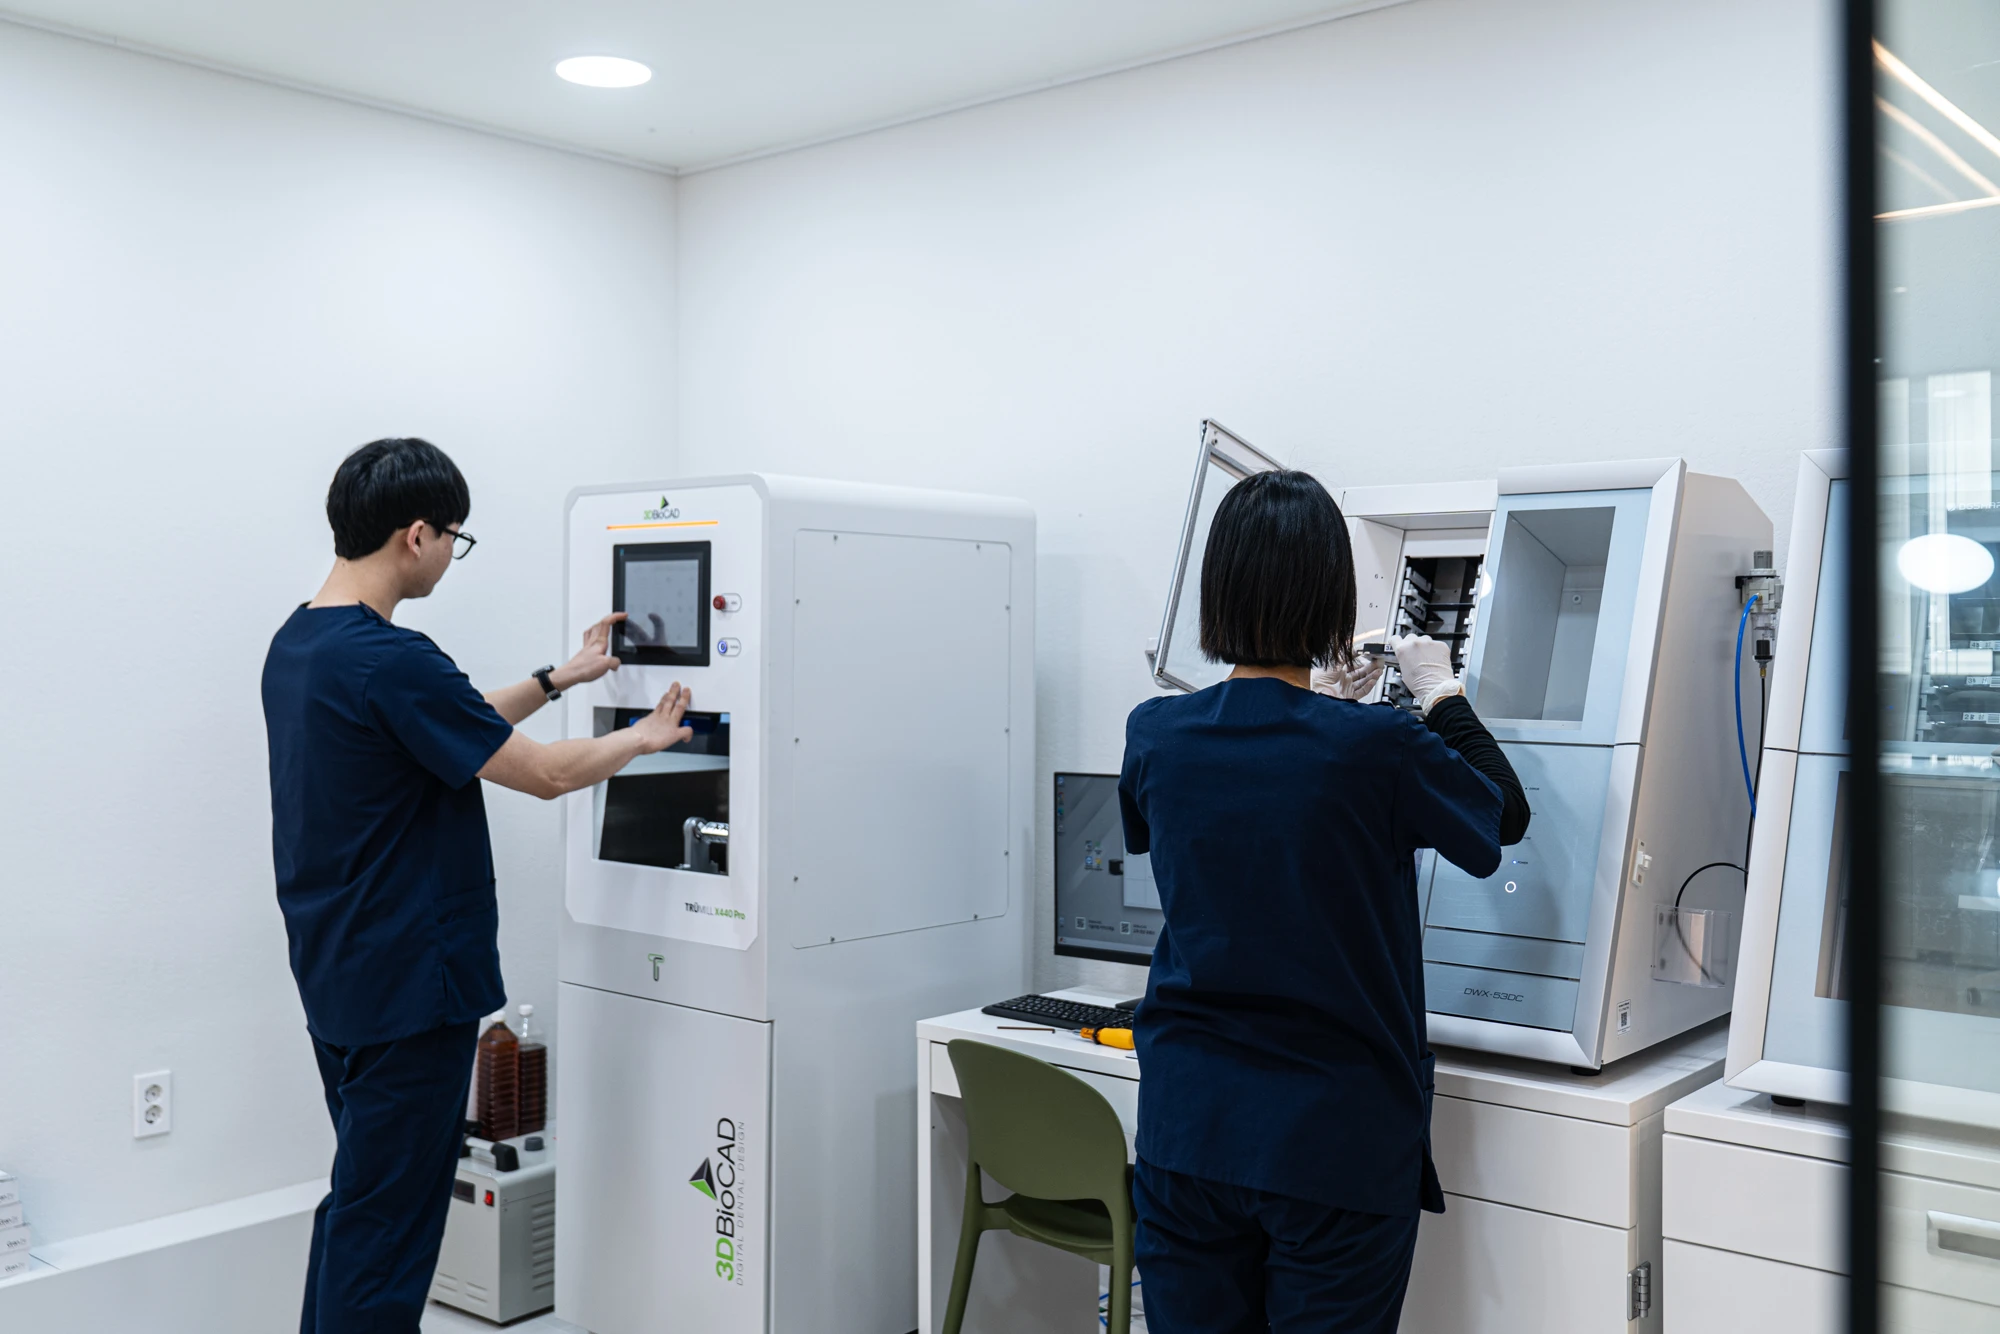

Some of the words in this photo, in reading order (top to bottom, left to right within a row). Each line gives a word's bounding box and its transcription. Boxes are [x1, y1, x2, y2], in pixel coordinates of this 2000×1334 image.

[714, 907, 733, 918] X440
[734, 910, 746, 920] Pro
[1463, 987, 1524, 1002] DWX-53DC
[737, 1121, 746, 1172] DESIGN
[716, 1117, 736, 1281] 3DBioCAD
[736, 1178, 745, 1229] DENTAL
[736, 1235, 745, 1286] DIGITAL
